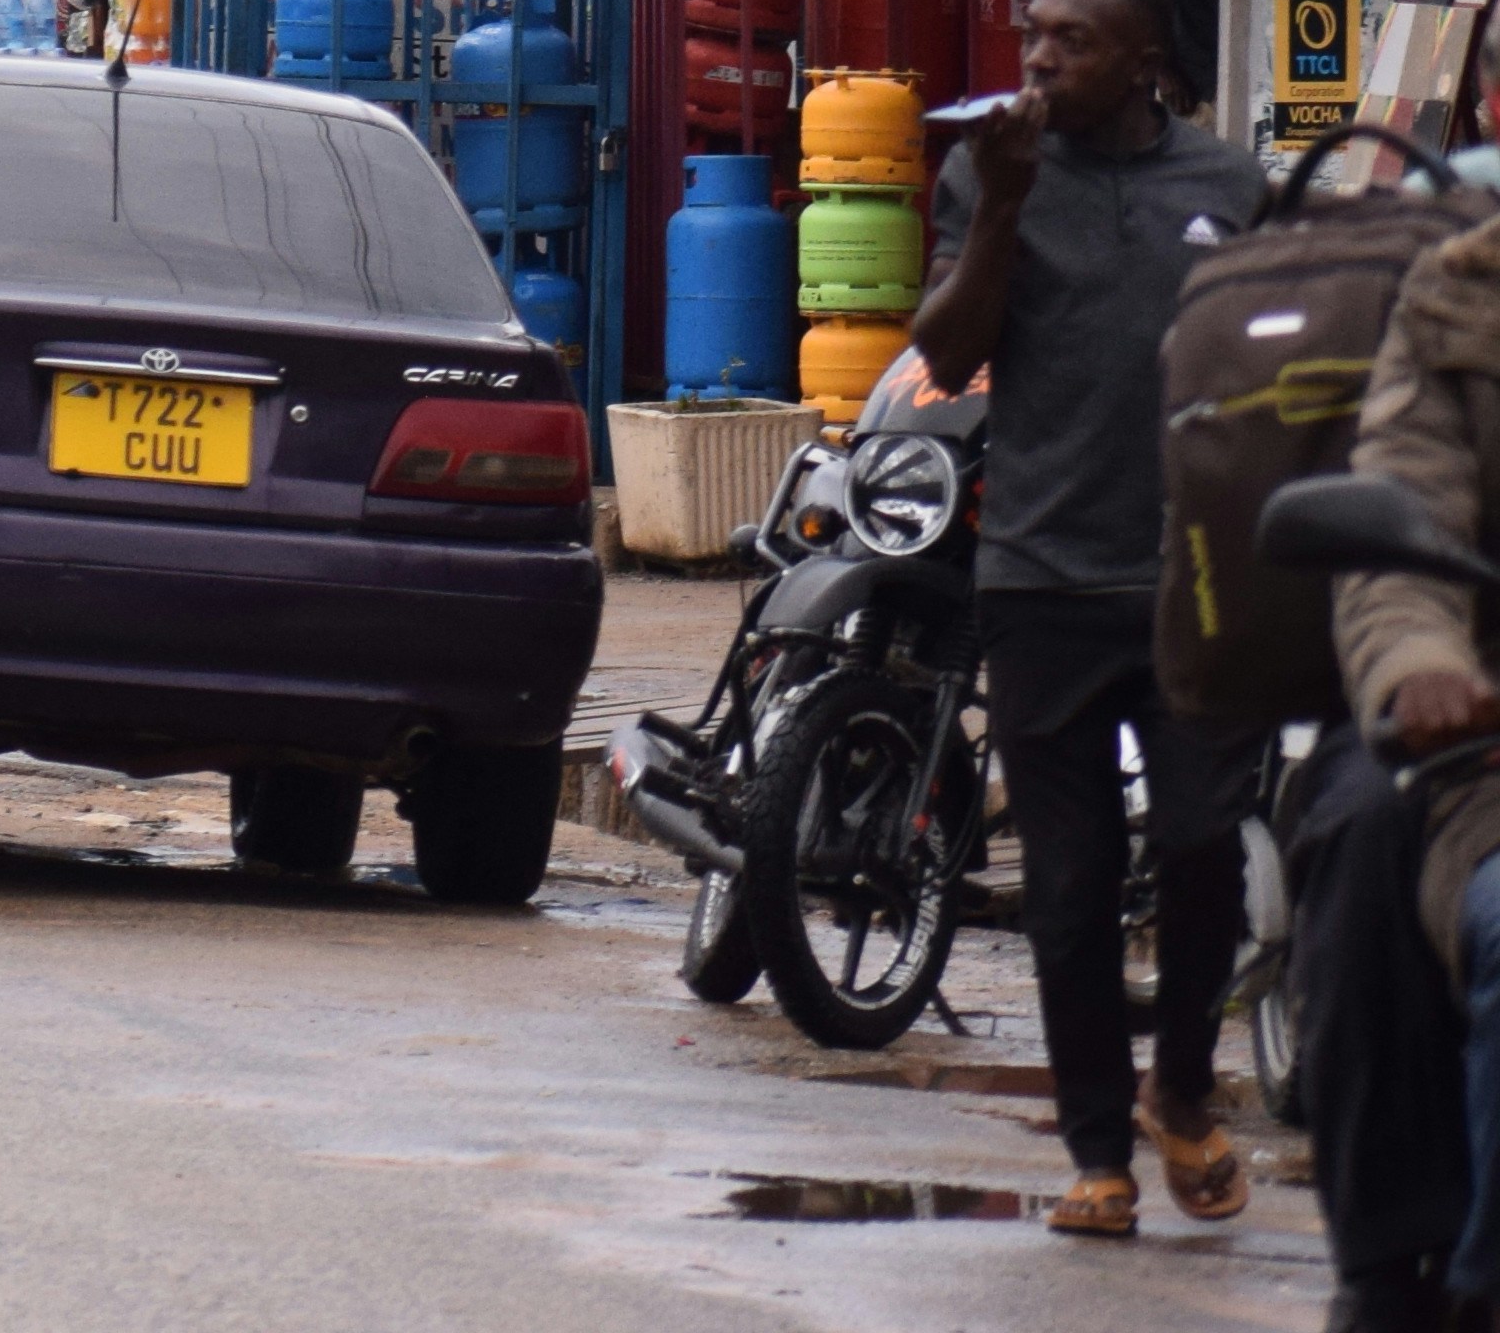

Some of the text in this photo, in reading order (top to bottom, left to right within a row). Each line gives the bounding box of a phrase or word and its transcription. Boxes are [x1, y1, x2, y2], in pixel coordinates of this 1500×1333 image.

[1289, 85, 1346, 100] Corporation
[1288, 105, 1342, 123] VOCHA
[402, 367, 520, 389] CARINA
[103, 381, 204, 429] T722
[125, 432, 201, 475] CUU
